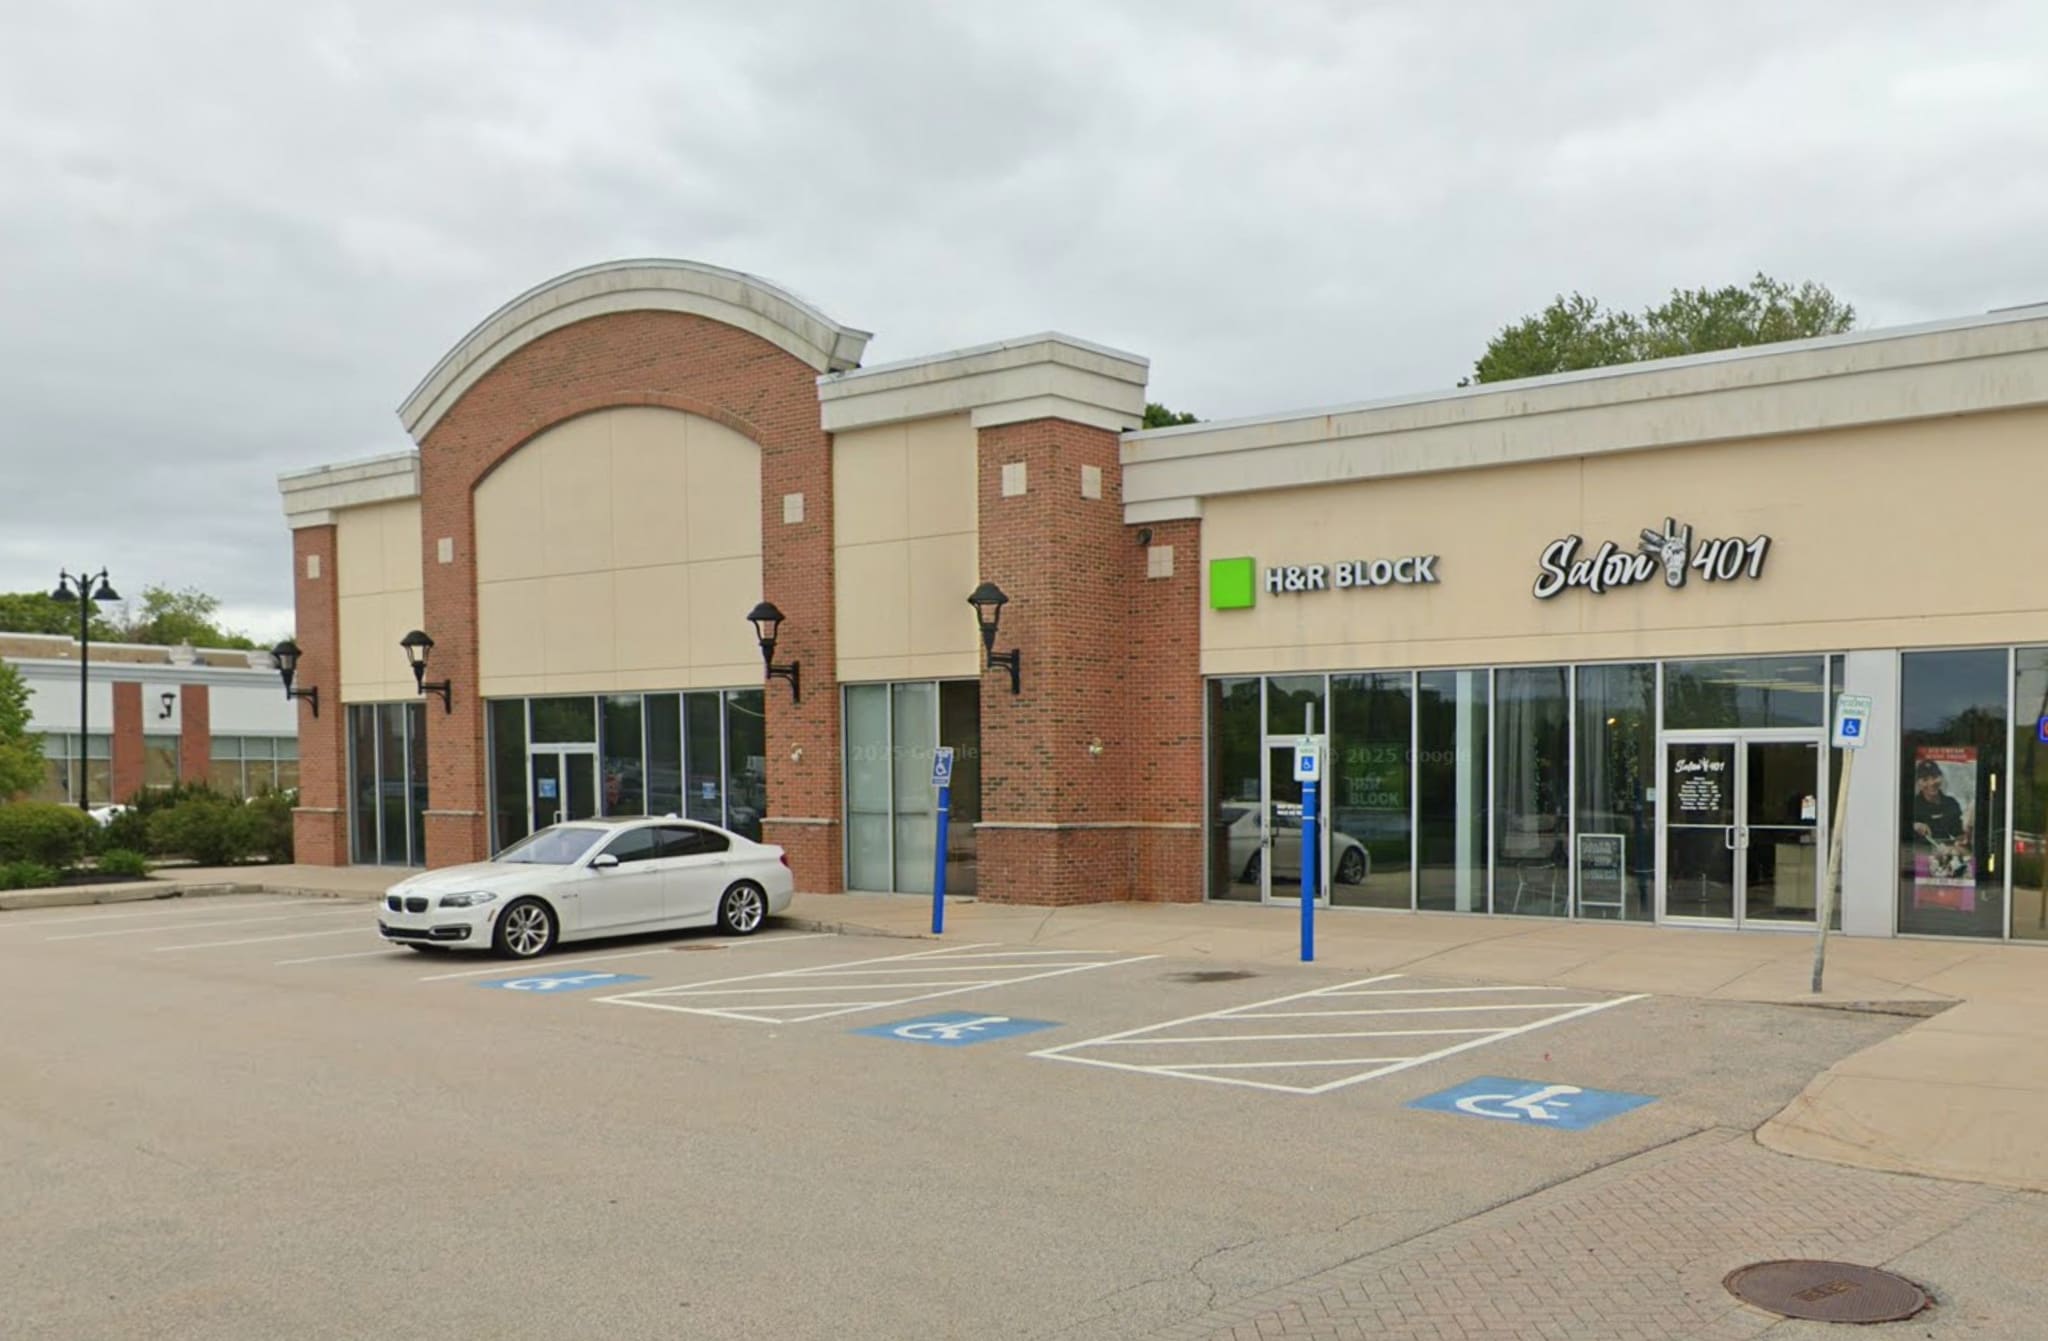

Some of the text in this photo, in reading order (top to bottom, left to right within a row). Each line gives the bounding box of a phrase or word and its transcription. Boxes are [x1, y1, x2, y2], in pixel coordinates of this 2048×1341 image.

[1265, 555, 1438, 594] H&R BLOCK
[1533, 534, 1771, 598] Salon 401
[1350, 792, 1400, 805] BLOCK
